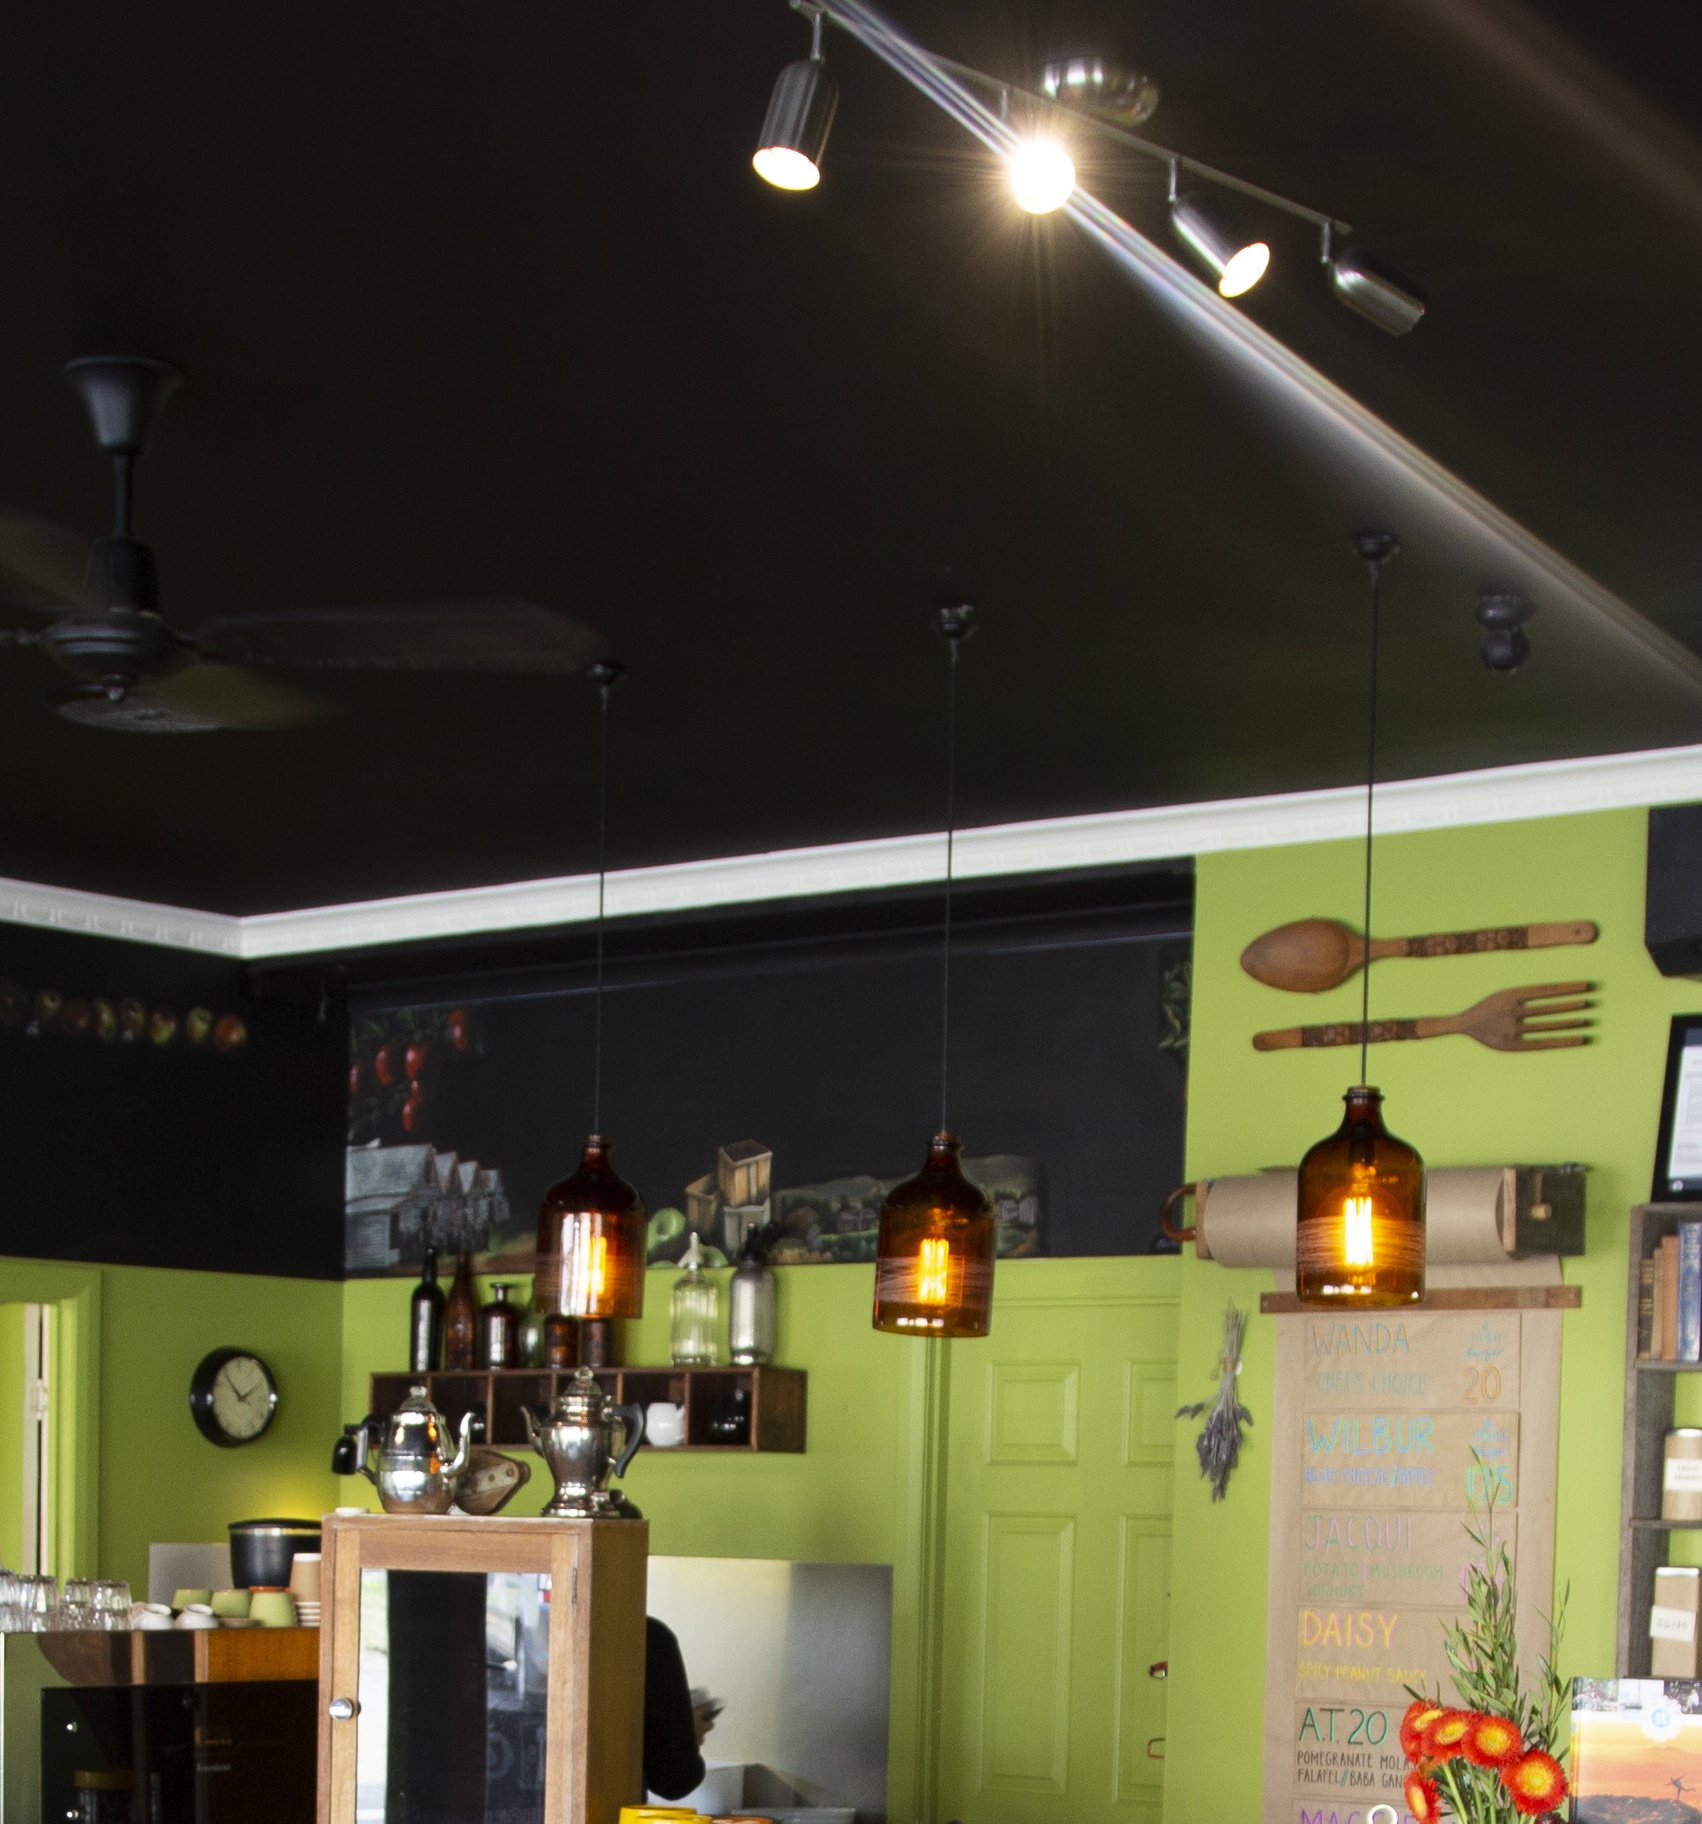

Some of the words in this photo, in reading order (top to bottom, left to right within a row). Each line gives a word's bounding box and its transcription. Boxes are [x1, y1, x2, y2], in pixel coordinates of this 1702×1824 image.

[1312, 1321, 1409, 1356] WANDA
[1460, 1365, 1502, 1406] 20
[1307, 1415, 1435, 1455] WILBUR
[1306, 1514, 1412, 1551] JACQUI
[1303, 1609, 1397, 1648] DAISY
[1348, 1708, 1389, 1745] 20
[1297, 1749, 1374, 1769] POMEGRANATE
[1380, 1754, 1414, 1771] MOLA
[1382, 1772, 1404, 1789] GAN
